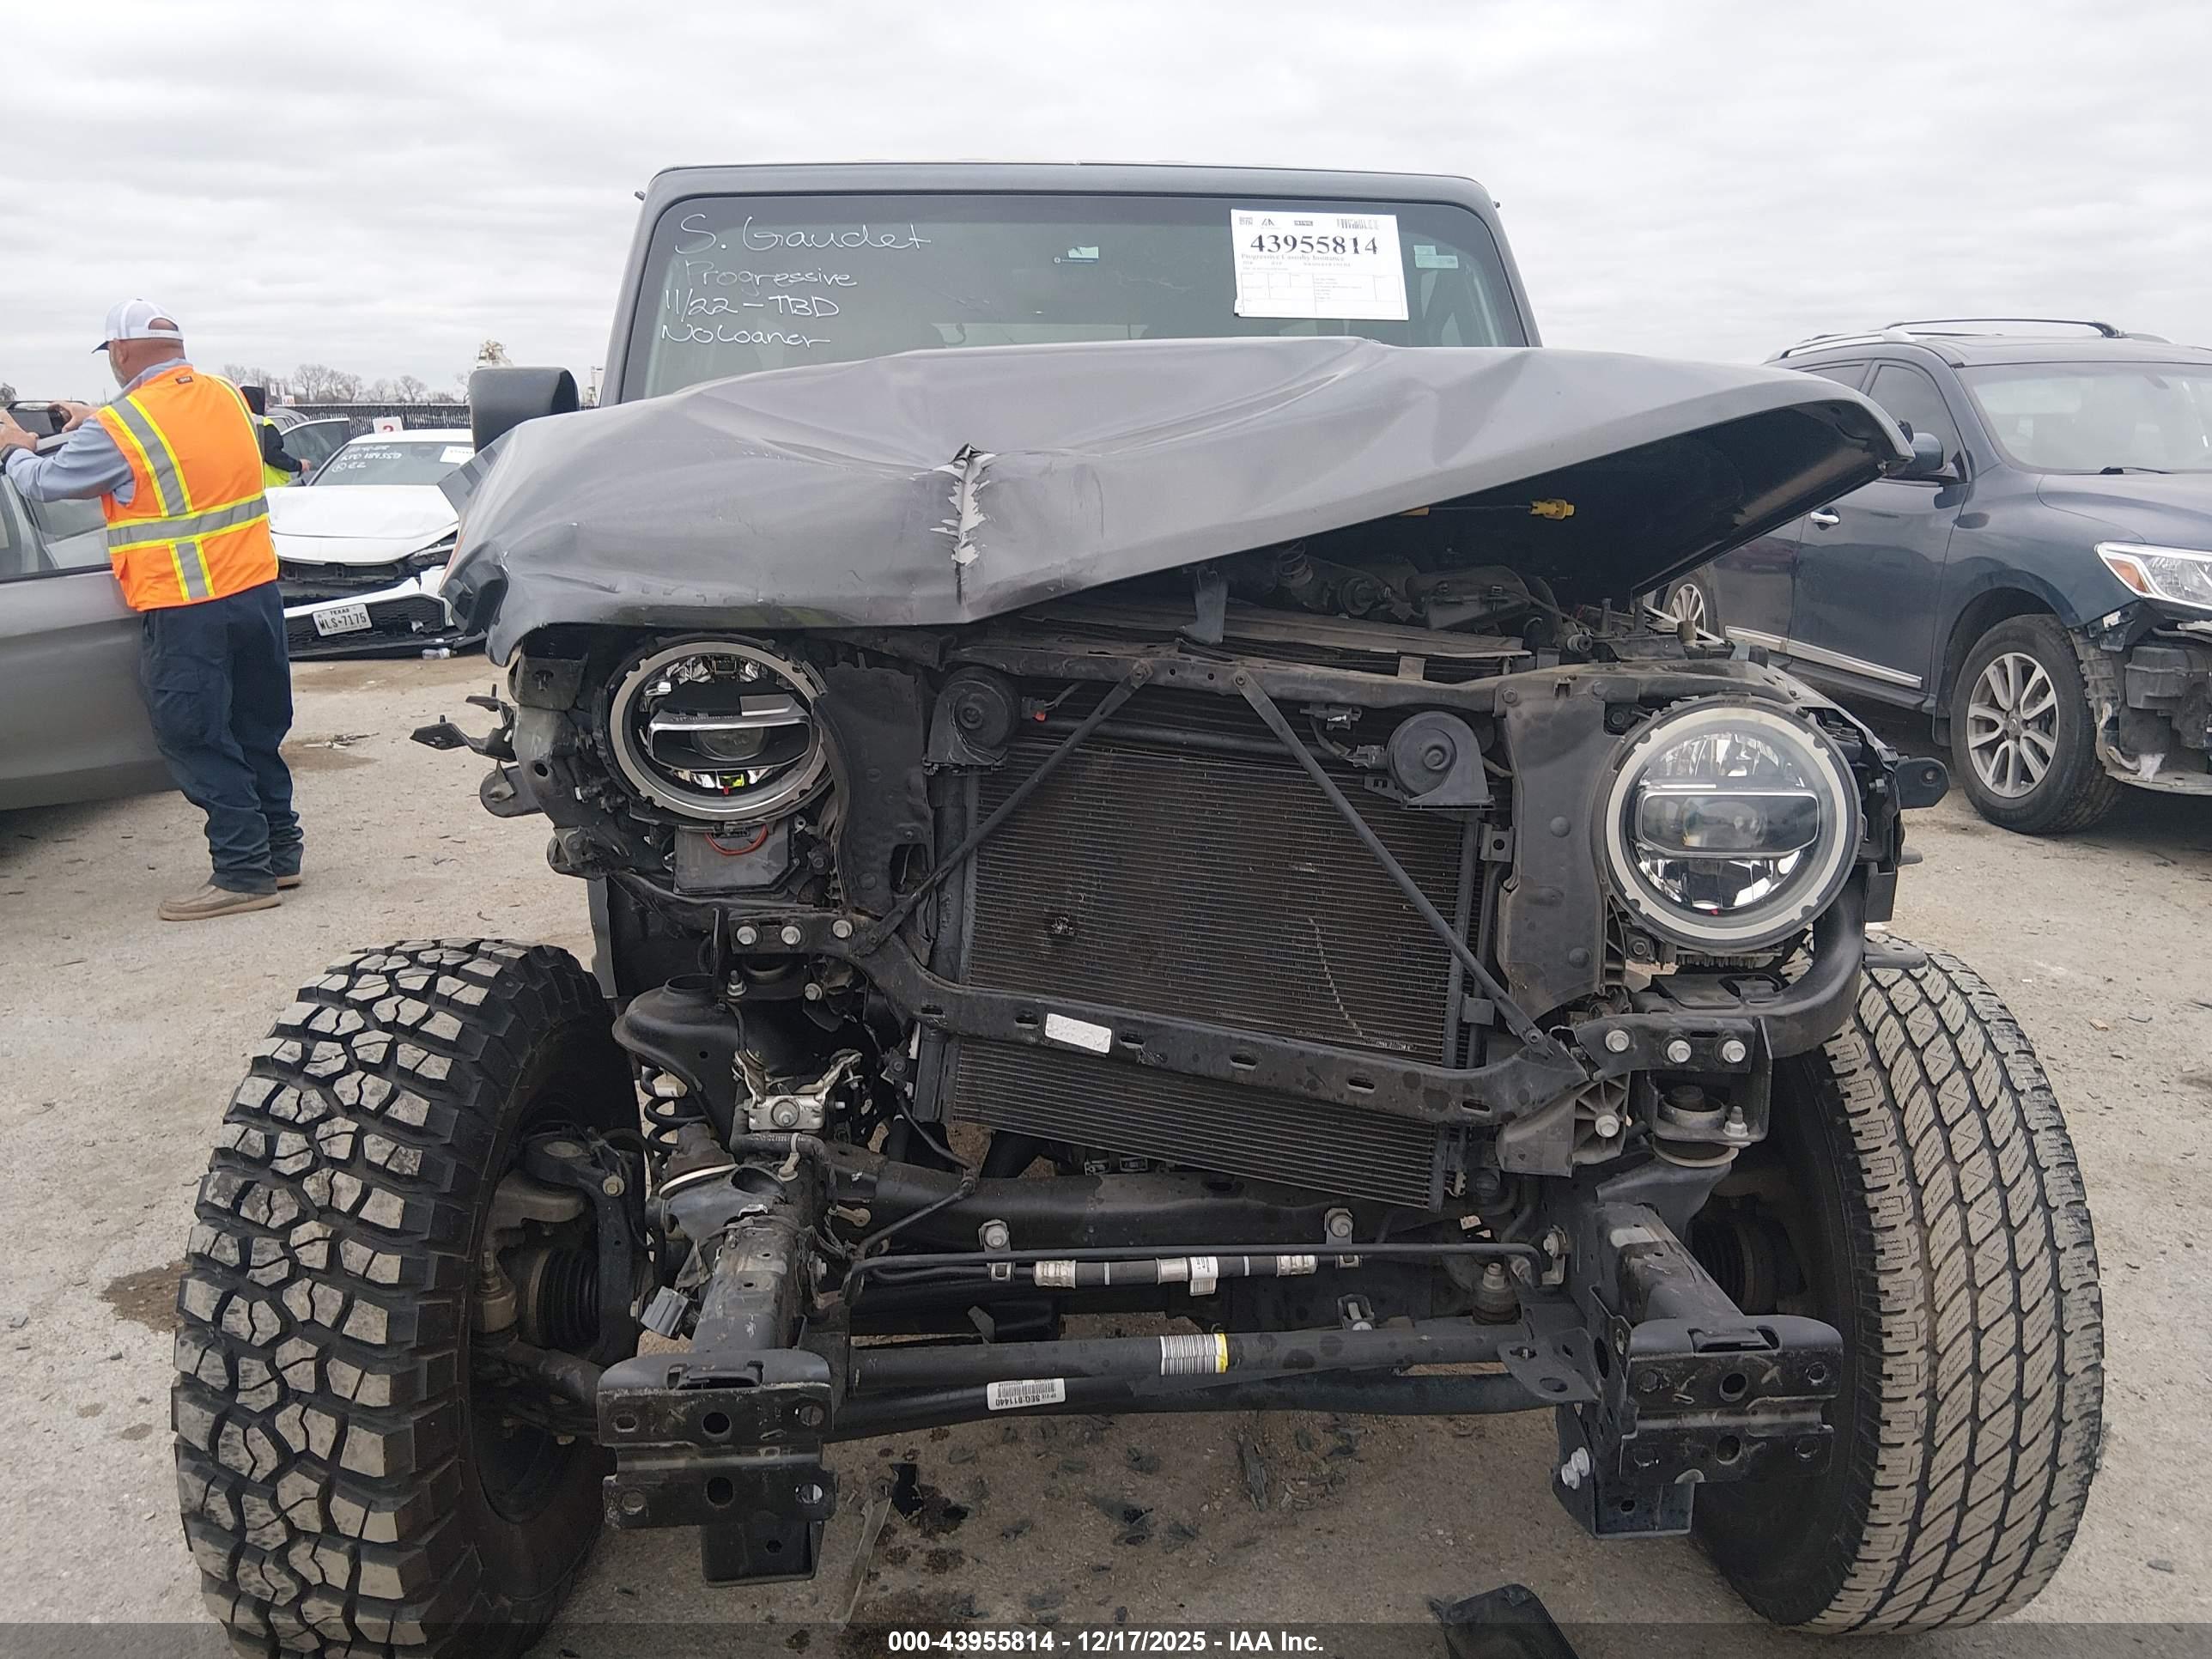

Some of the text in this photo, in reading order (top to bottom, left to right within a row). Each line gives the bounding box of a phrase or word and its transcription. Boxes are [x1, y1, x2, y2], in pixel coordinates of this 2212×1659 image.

[675, 214, 932, 255] S. Gaudet
[1250, 234, 1378, 255] 43955814
[685, 259, 858, 296] Progressive
